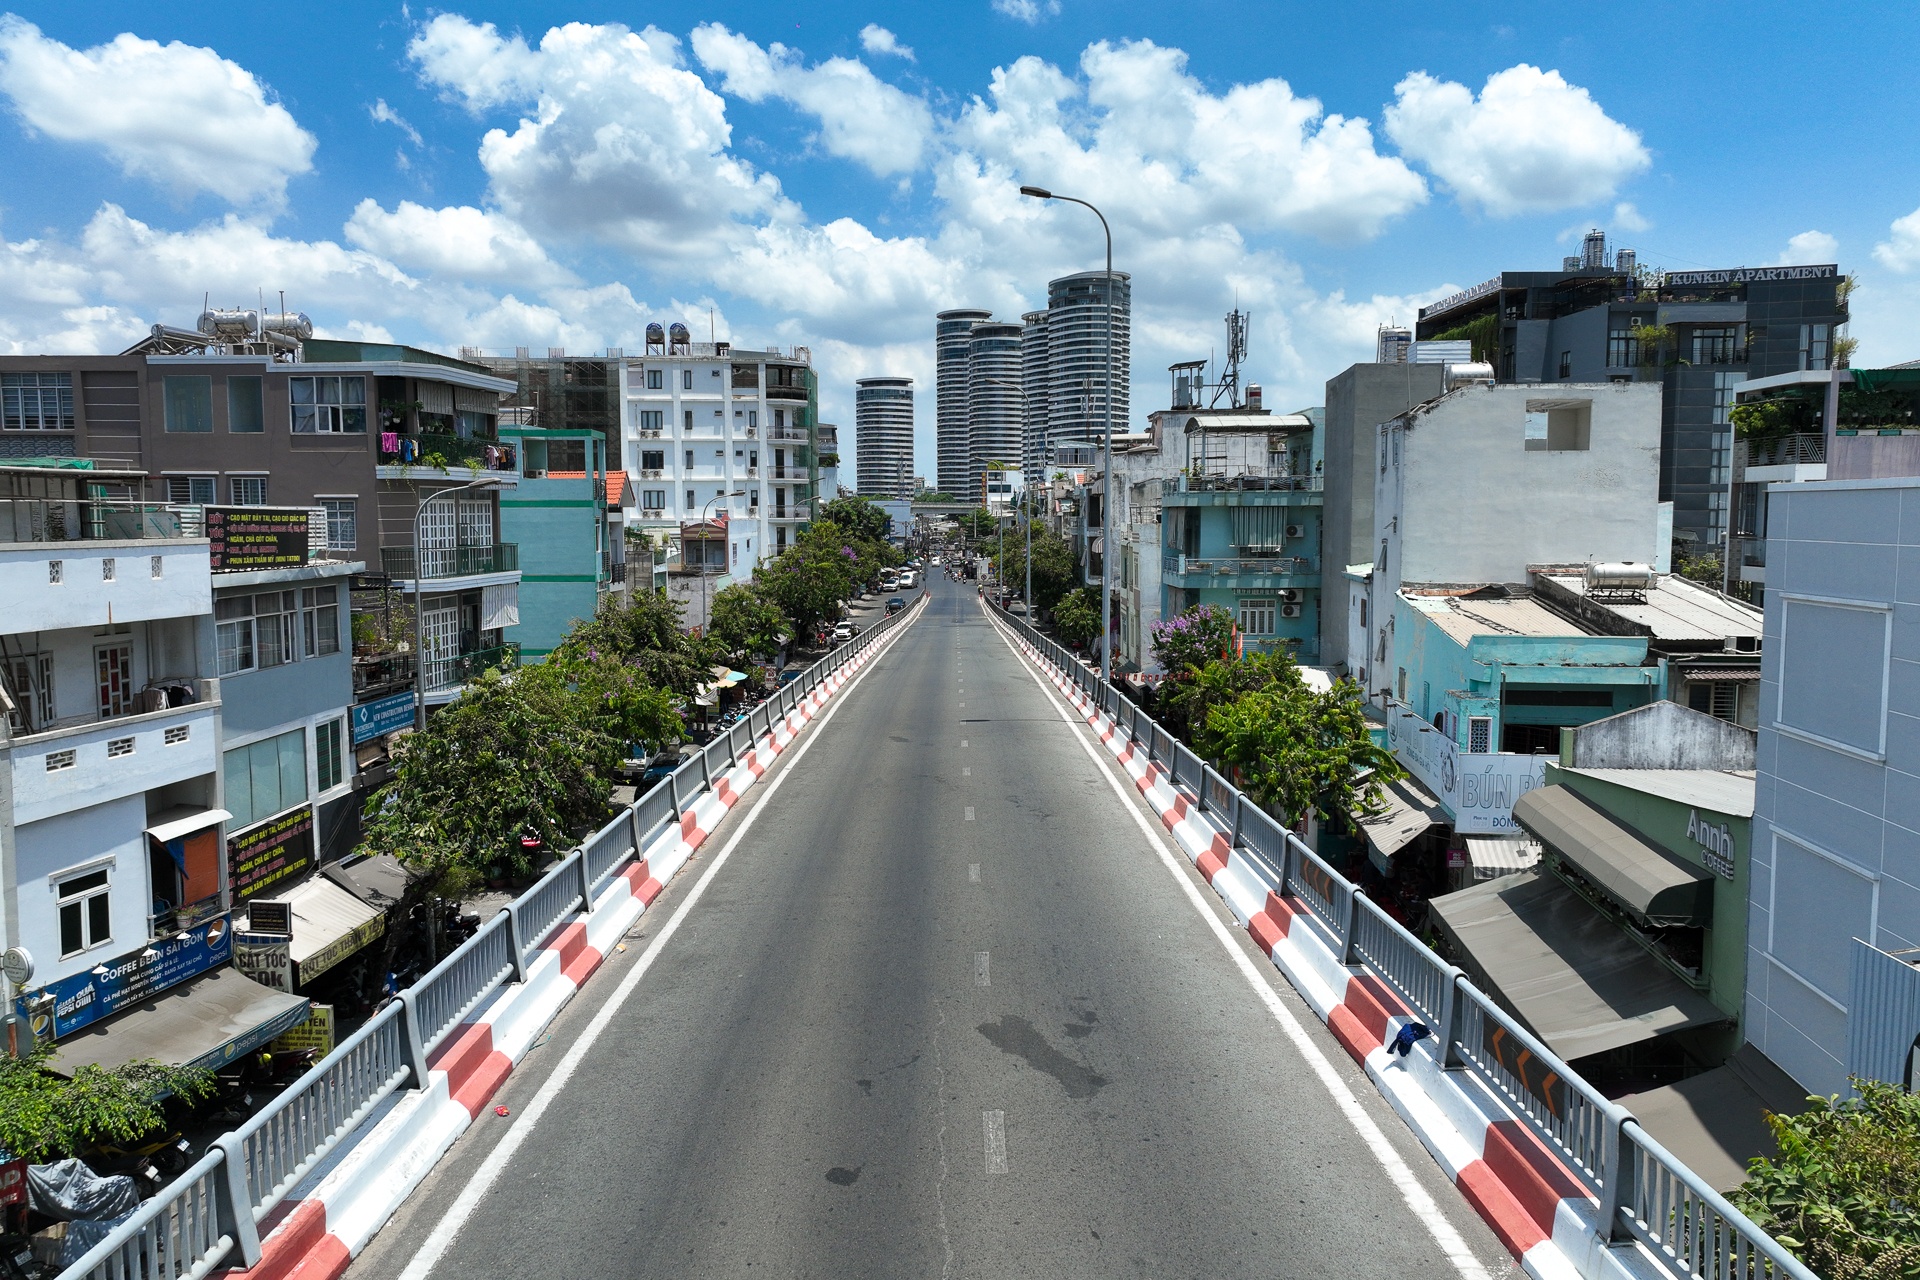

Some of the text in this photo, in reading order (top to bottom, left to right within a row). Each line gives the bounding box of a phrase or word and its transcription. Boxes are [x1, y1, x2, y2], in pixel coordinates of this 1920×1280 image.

[1672, 266, 1834, 285] KUNKIN APARTMENT
[208, 526, 224, 538] TÓC
[1462, 765, 1545, 809] BÚN B
[1686, 809, 1734, 861] Annh
[1701, 850, 1734, 880] COFFEE
[340, 929, 366, 952] THANH
[100, 932, 204, 984] COFFEE BEAN SÀI GÒN
[209, 949, 228, 965] pepsi
[239, 948, 286, 968] CẮT TÓC
[103, 995, 111, 1003] CÀ
[112, 990, 120, 1000] PHÊ
[165, 967, 176, 976] RANG
[177, 963, 185, 972] XAY
[130, 974, 140, 983] NHÀ
[76, 981, 95, 999] QUÁ
[57, 1003, 75, 1017] PEPSI
[309, 1015, 325, 1027] YẾN
[236, 1033, 258, 1052] pepsi
